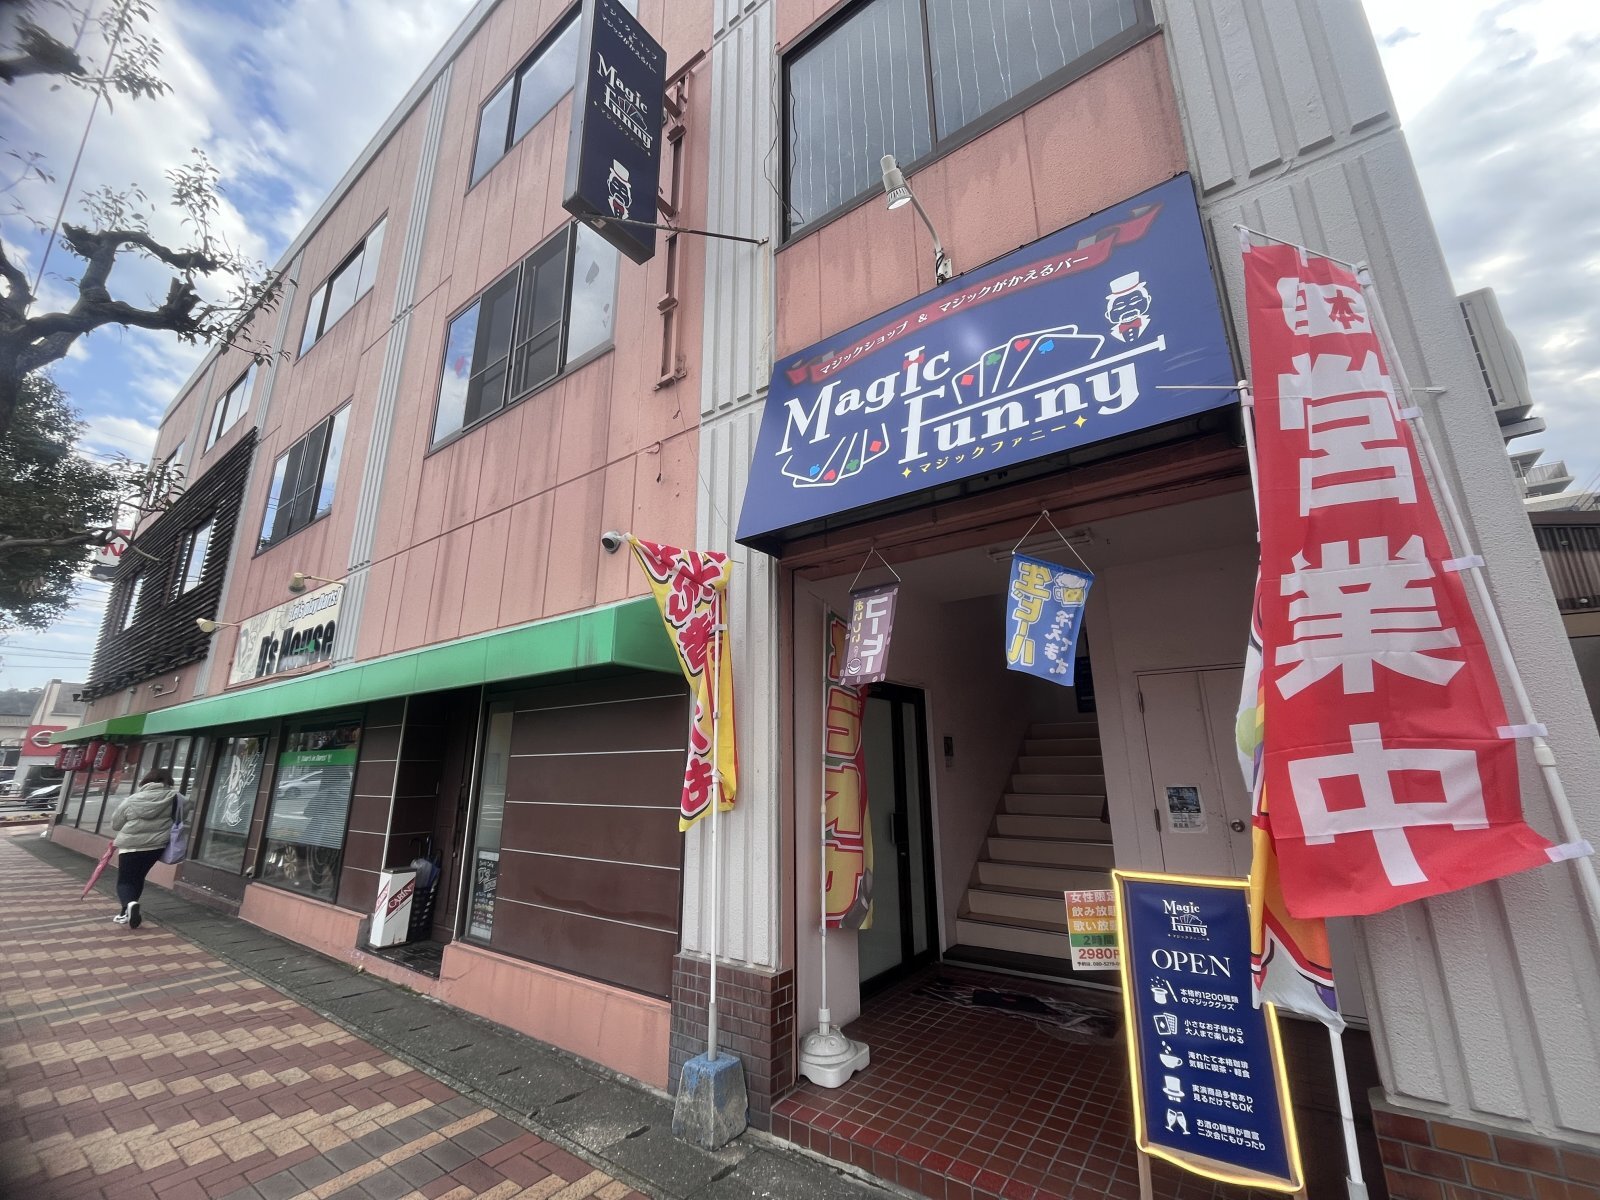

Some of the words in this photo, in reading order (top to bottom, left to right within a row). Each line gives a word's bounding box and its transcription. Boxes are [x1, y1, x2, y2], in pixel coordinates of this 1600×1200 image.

[596, 51, 649, 115] Magic
[602, 84, 653, 149] Funny
[820, 320, 909, 375] マジックショップ
[938, 255, 1089, 313] マジックがかえるバー
[897, 335, 1166, 465] Funny
[919, 424, 1067, 474] マジックファニー
[275, 619, 338, 672] House
[1162, 899, 1200, 915] Magic
[1171, 916, 1208, 936] Funny
[1151, 948, 1231, 978] OPEN
[1181, 996, 1235, 1011] のマジックグッズ
[1184, 1019, 1243, 1036] 小さなお子様から
[1185, 1027, 1244, 1044] 大人まで楽しめる
[1193, 1093, 1254, 1113] 見るだけでもOK
